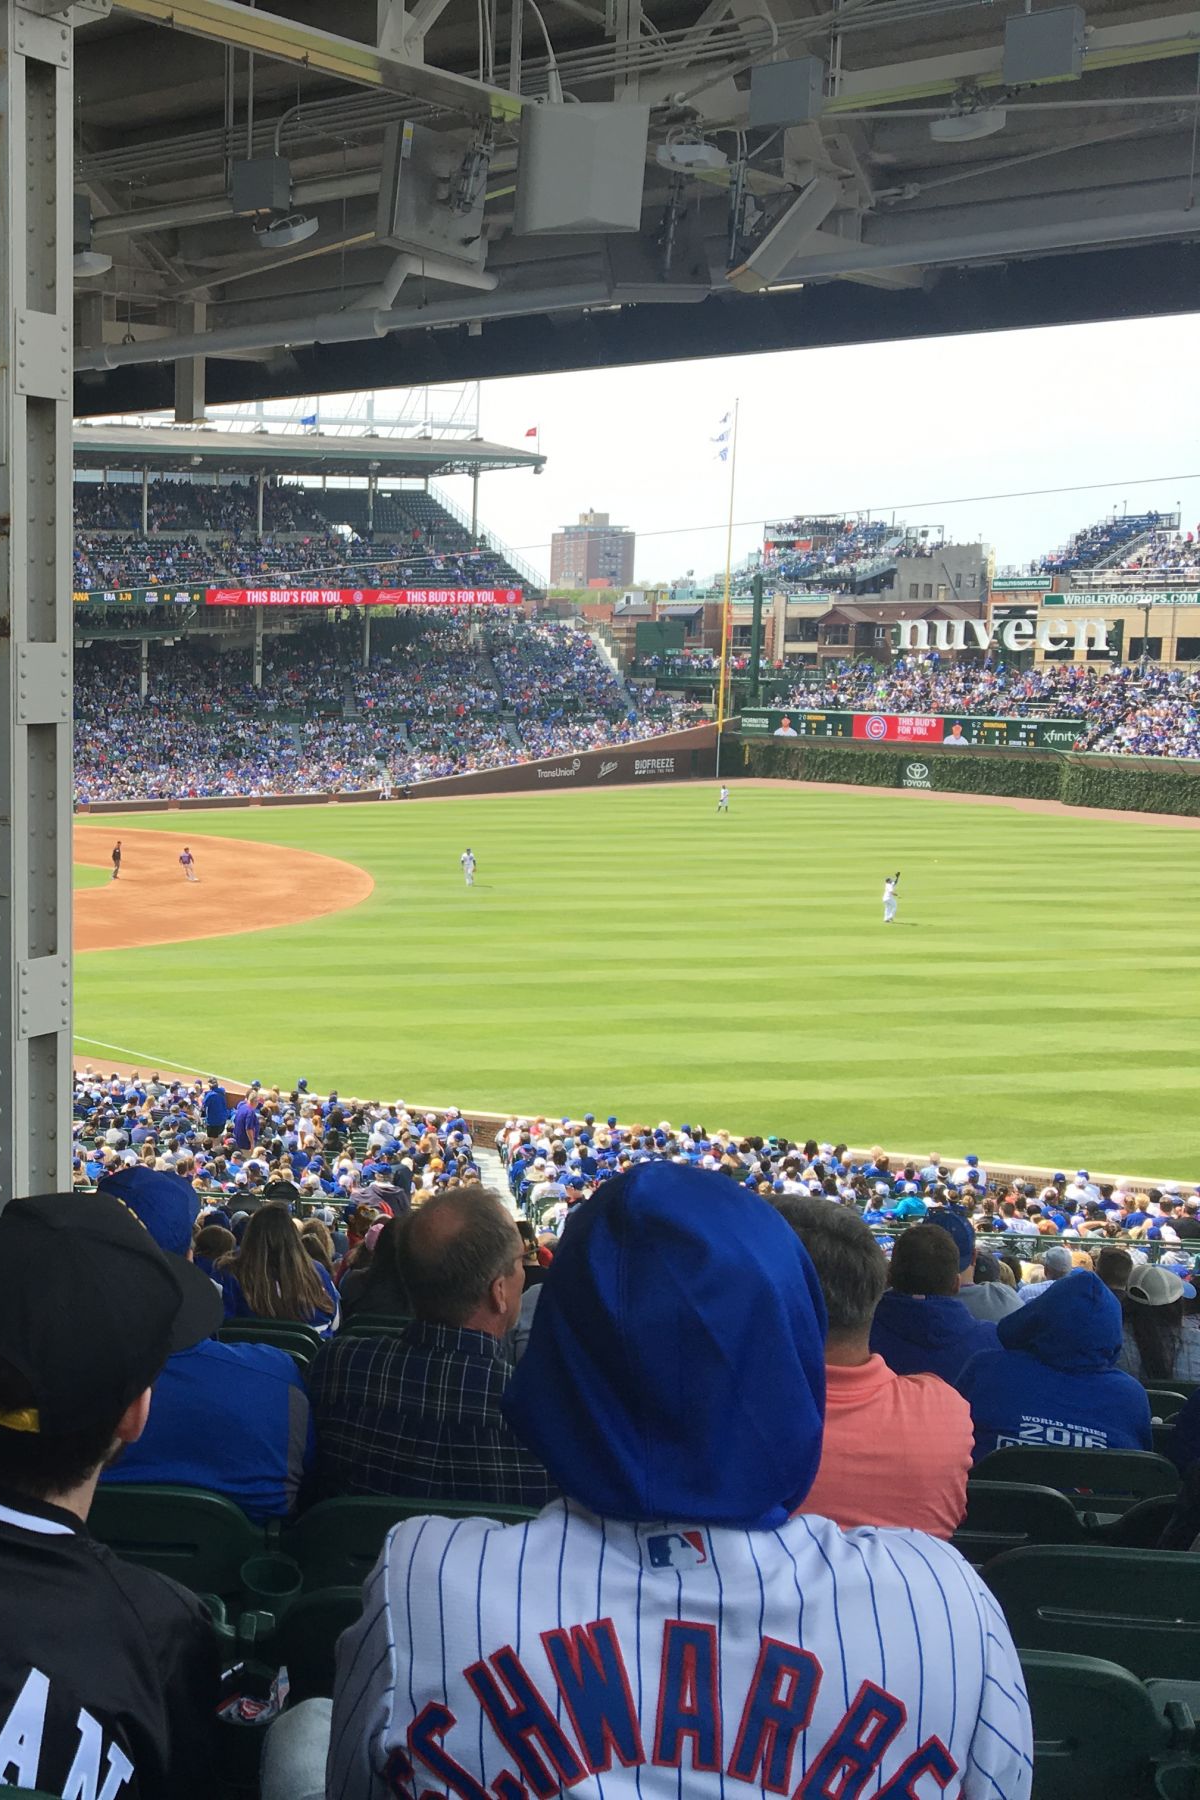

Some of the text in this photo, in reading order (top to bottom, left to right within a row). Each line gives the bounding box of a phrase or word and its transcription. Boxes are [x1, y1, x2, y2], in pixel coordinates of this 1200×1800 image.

[73, 592, 90, 601] ANA
[103, 592, 116, 601] ERA
[246, 591, 267, 602] THIS
[270, 591, 298, 602] BUD'S
[301, 591, 320, 602] FOR
[321, 591, 343, 602] YOU.
[406, 591, 427, 602] THIS
[428, 591, 456, 602] BUD'S
[458, 591, 475, 602] FOR
[477, 591, 497, 602] YOU.
[1063, 593, 1198, 604] WRIGLEYROOFTOPS.COM
[897, 618, 1110, 651] nuveen
[897, 717, 937, 727] THIS BUD'S
[897, 726, 928, 736] FOR YOU.
[1043, 729, 1080, 743] xfinity
[635, 758, 675, 770] BIOFREEZE
[537, 767, 575, 778] TransUnion
[903, 779, 932, 788] TOYOTA
[1021, 1415, 1108, 1438] WORLD SERIES
